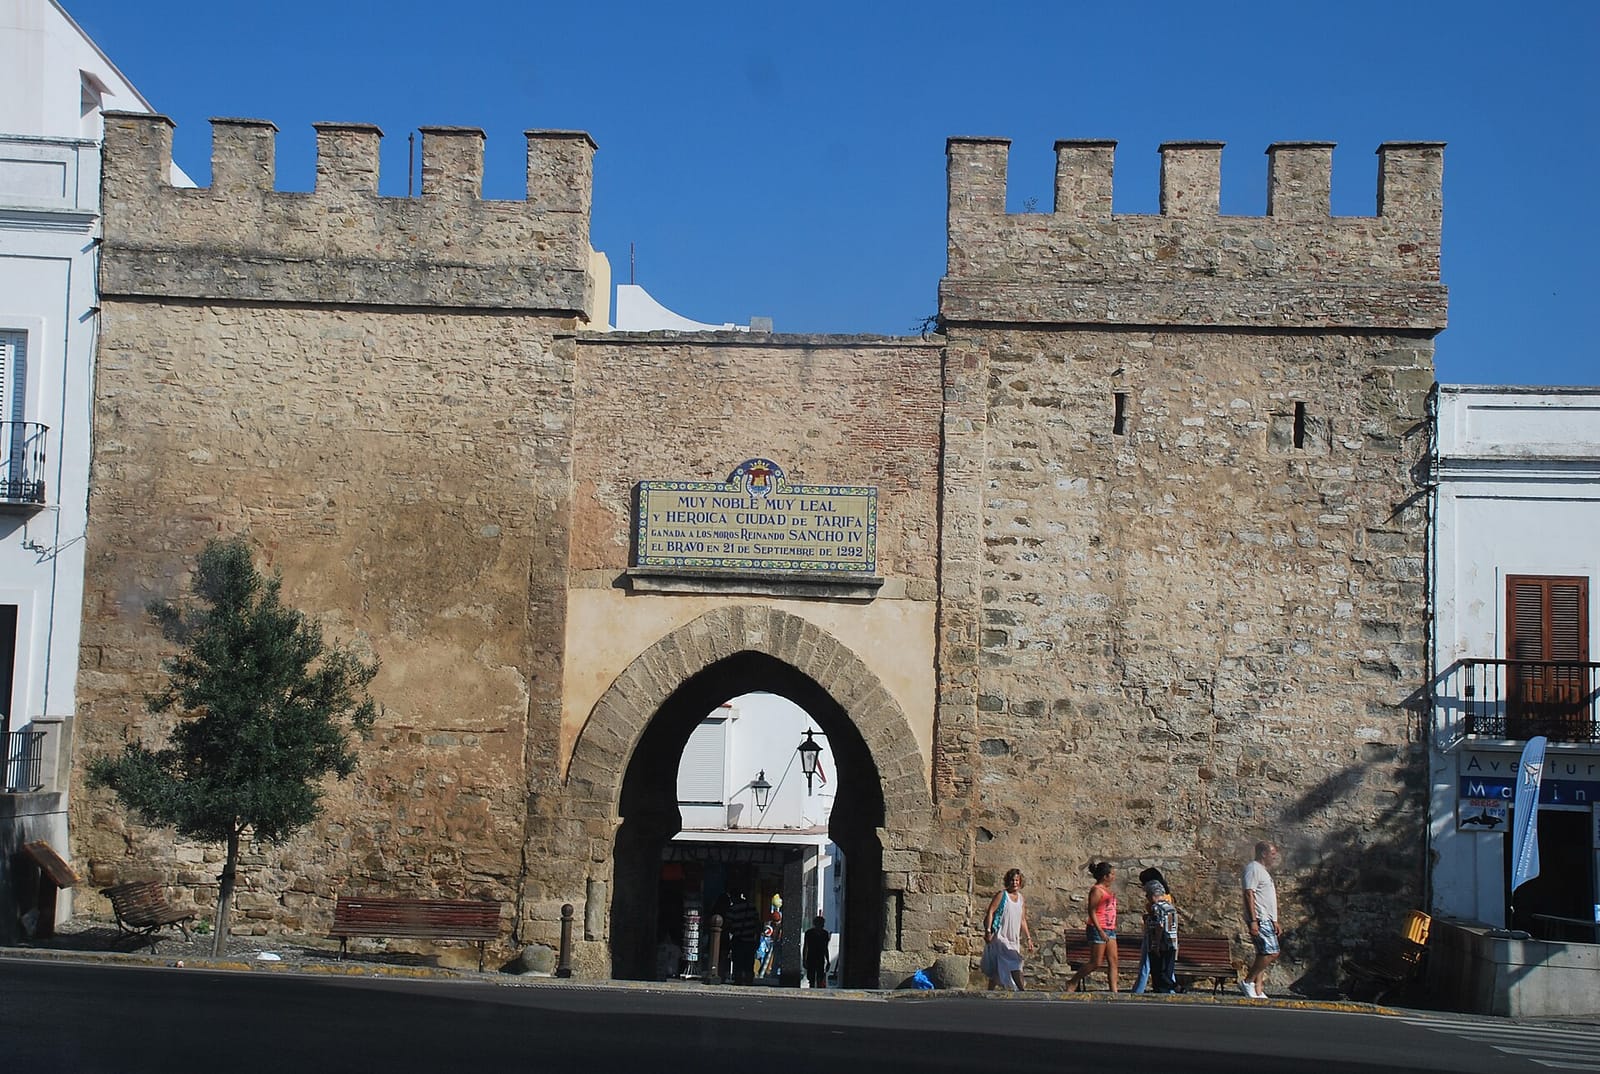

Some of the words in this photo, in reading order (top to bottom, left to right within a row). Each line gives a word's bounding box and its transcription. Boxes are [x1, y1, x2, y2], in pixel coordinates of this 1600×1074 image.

[678, 497, 708, 508] MUY
[713, 498, 758, 510] NOBLE
[766, 499, 795, 510] MUY
[800, 500, 836, 512] LEAL
[666, 512, 727, 524] HEROICA
[736, 513, 786, 525] CIUDAD
[815, 516, 862, 528] TARIFA
[652, 529, 686, 538] GANADA
[713, 531, 739, 540] MOROS
[789, 530, 844, 542] SANCHO
[848, 532, 863, 542] IV
[667, 541, 703, 553] BRAVO
[723, 543, 734, 553] 21
[837, 547, 863, 557] 1292
[1467, 756, 1595, 774] Avetur
[1468, 781, 1586, 800] Main
